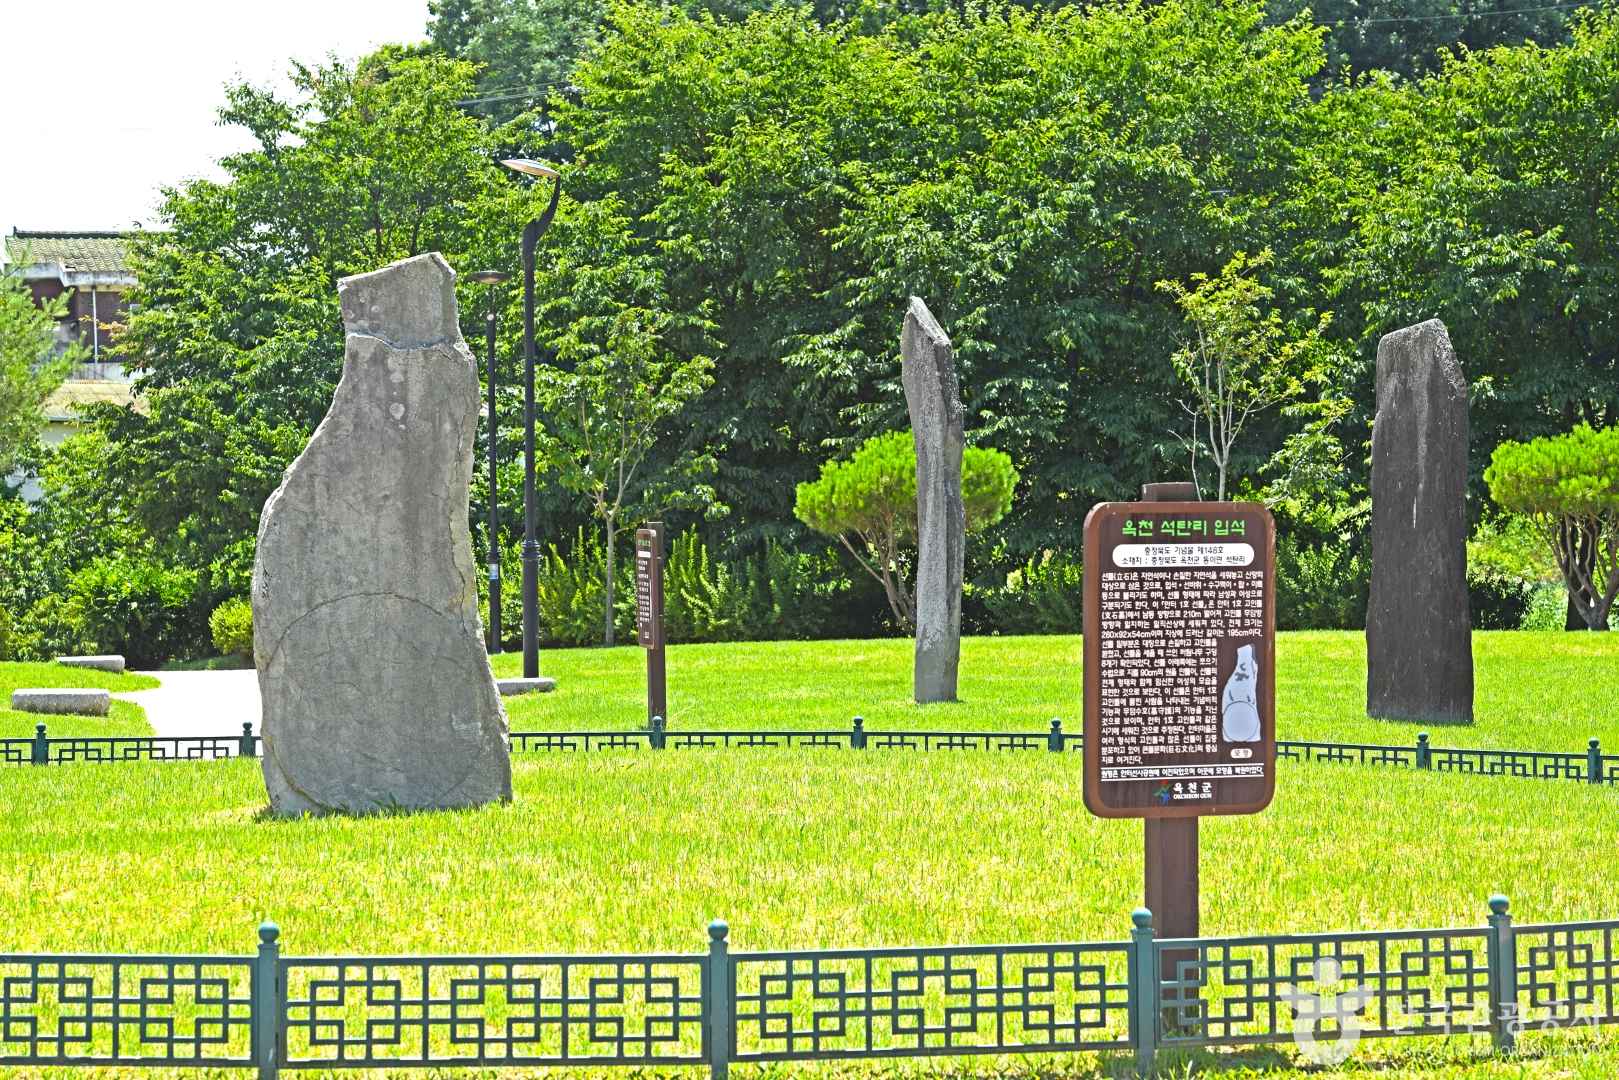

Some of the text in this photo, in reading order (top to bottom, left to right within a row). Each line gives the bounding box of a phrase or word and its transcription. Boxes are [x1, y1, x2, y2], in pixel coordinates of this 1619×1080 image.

[1122, 519, 1245, 537] 옥천 석탄리 입석
[1144, 546, 1170, 556] 충청북도
[1174, 546, 1194, 555] 기념물
[1121, 556, 1142, 565] 소재지
[1151, 556, 1177, 565] 충청북도
[1181, 556, 1200, 565] 옥천군
[1226, 555, 1245, 564] 석탄리
[1173, 782, 1212, 794] 옥천군
